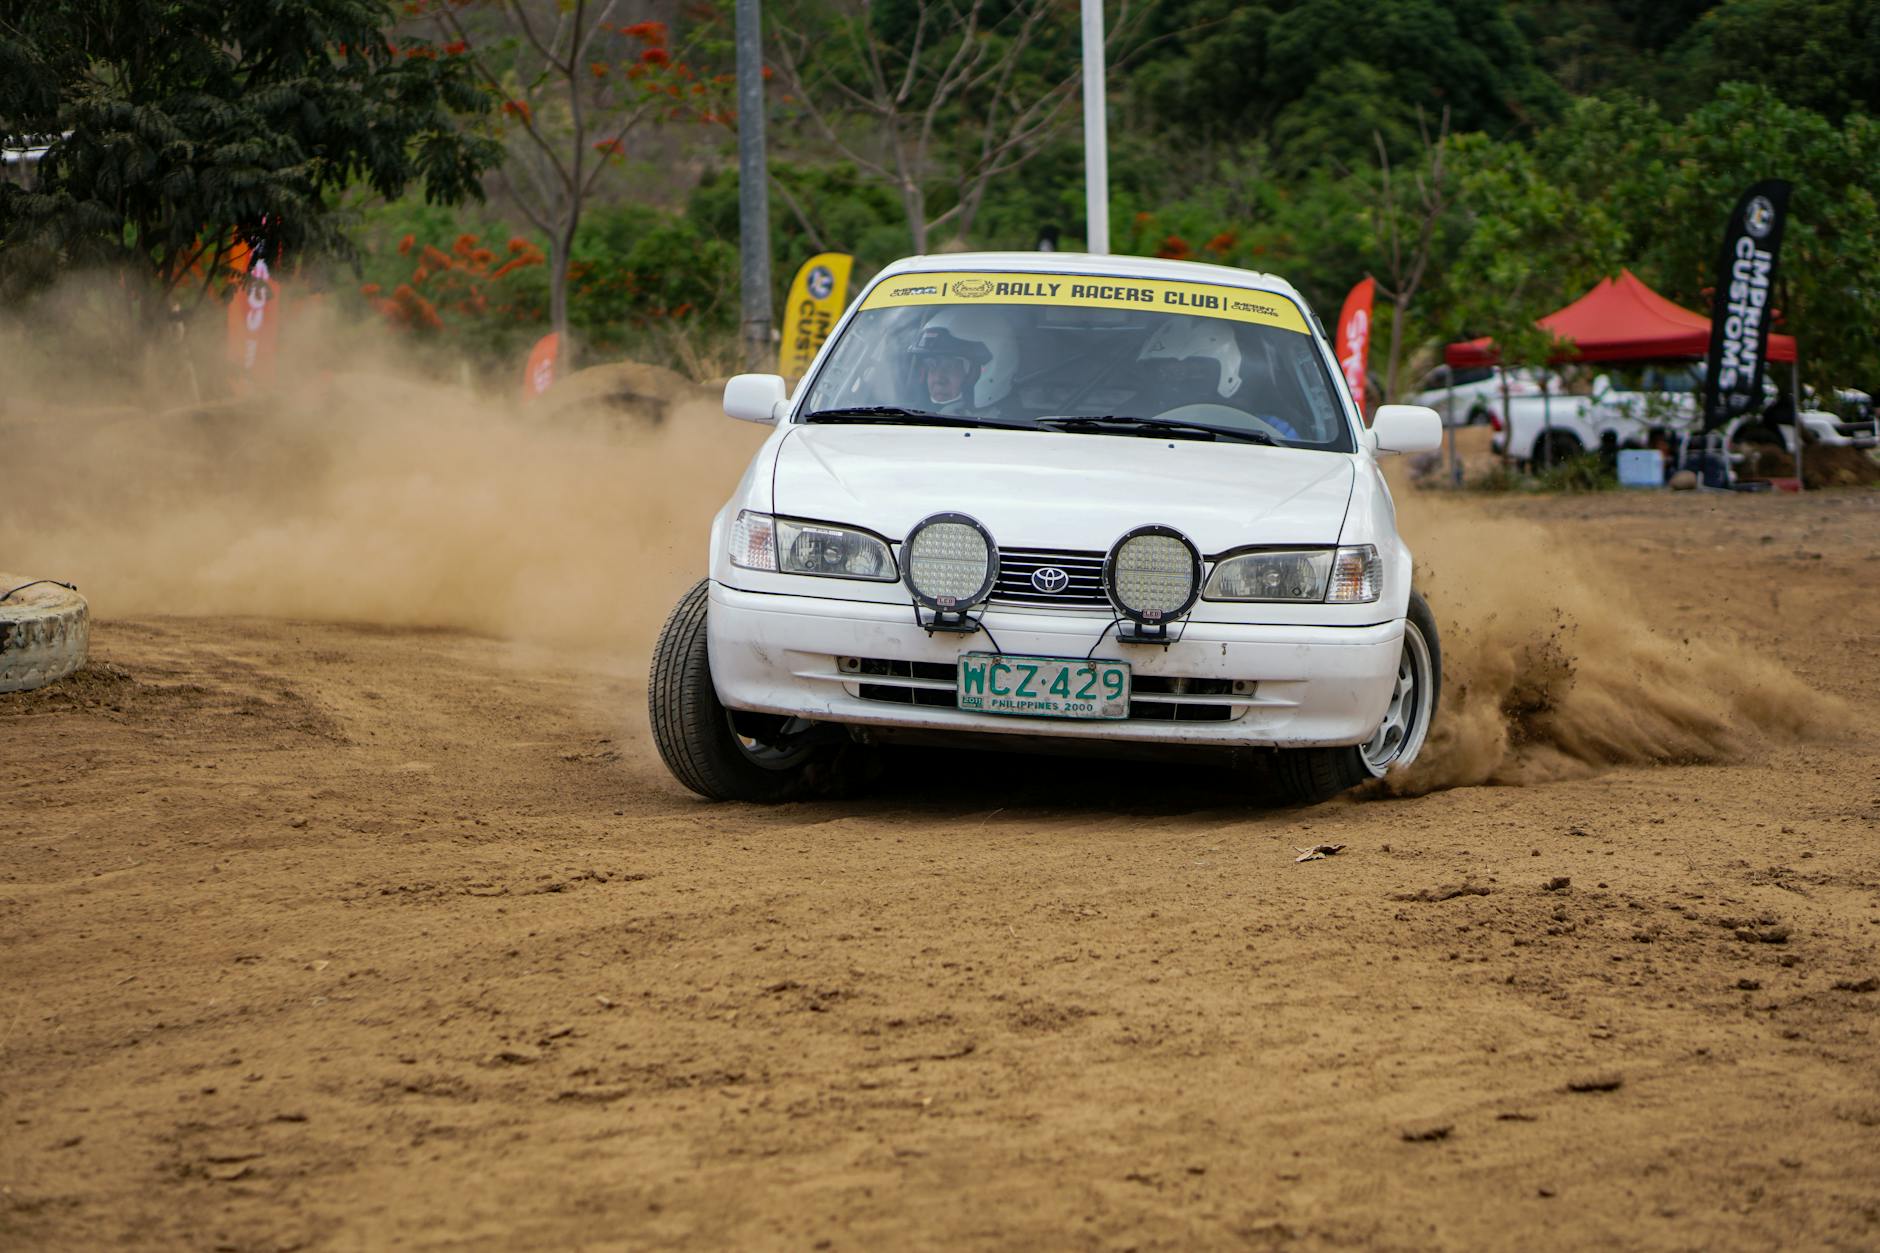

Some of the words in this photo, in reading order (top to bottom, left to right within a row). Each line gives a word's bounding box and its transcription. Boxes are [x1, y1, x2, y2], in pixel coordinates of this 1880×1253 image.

[996, 282, 1061, 297] RALLY
[1071, 284, 1154, 302] RACERS
[1164, 290, 1218, 309] CLUB
[1718, 236, 1755, 390] CUSTOMS
[1739, 249, 1772, 385] IMPRINT
[992, 700, 1059, 711] PHILIPPINES
[1064, 703, 1093, 712] 2000
